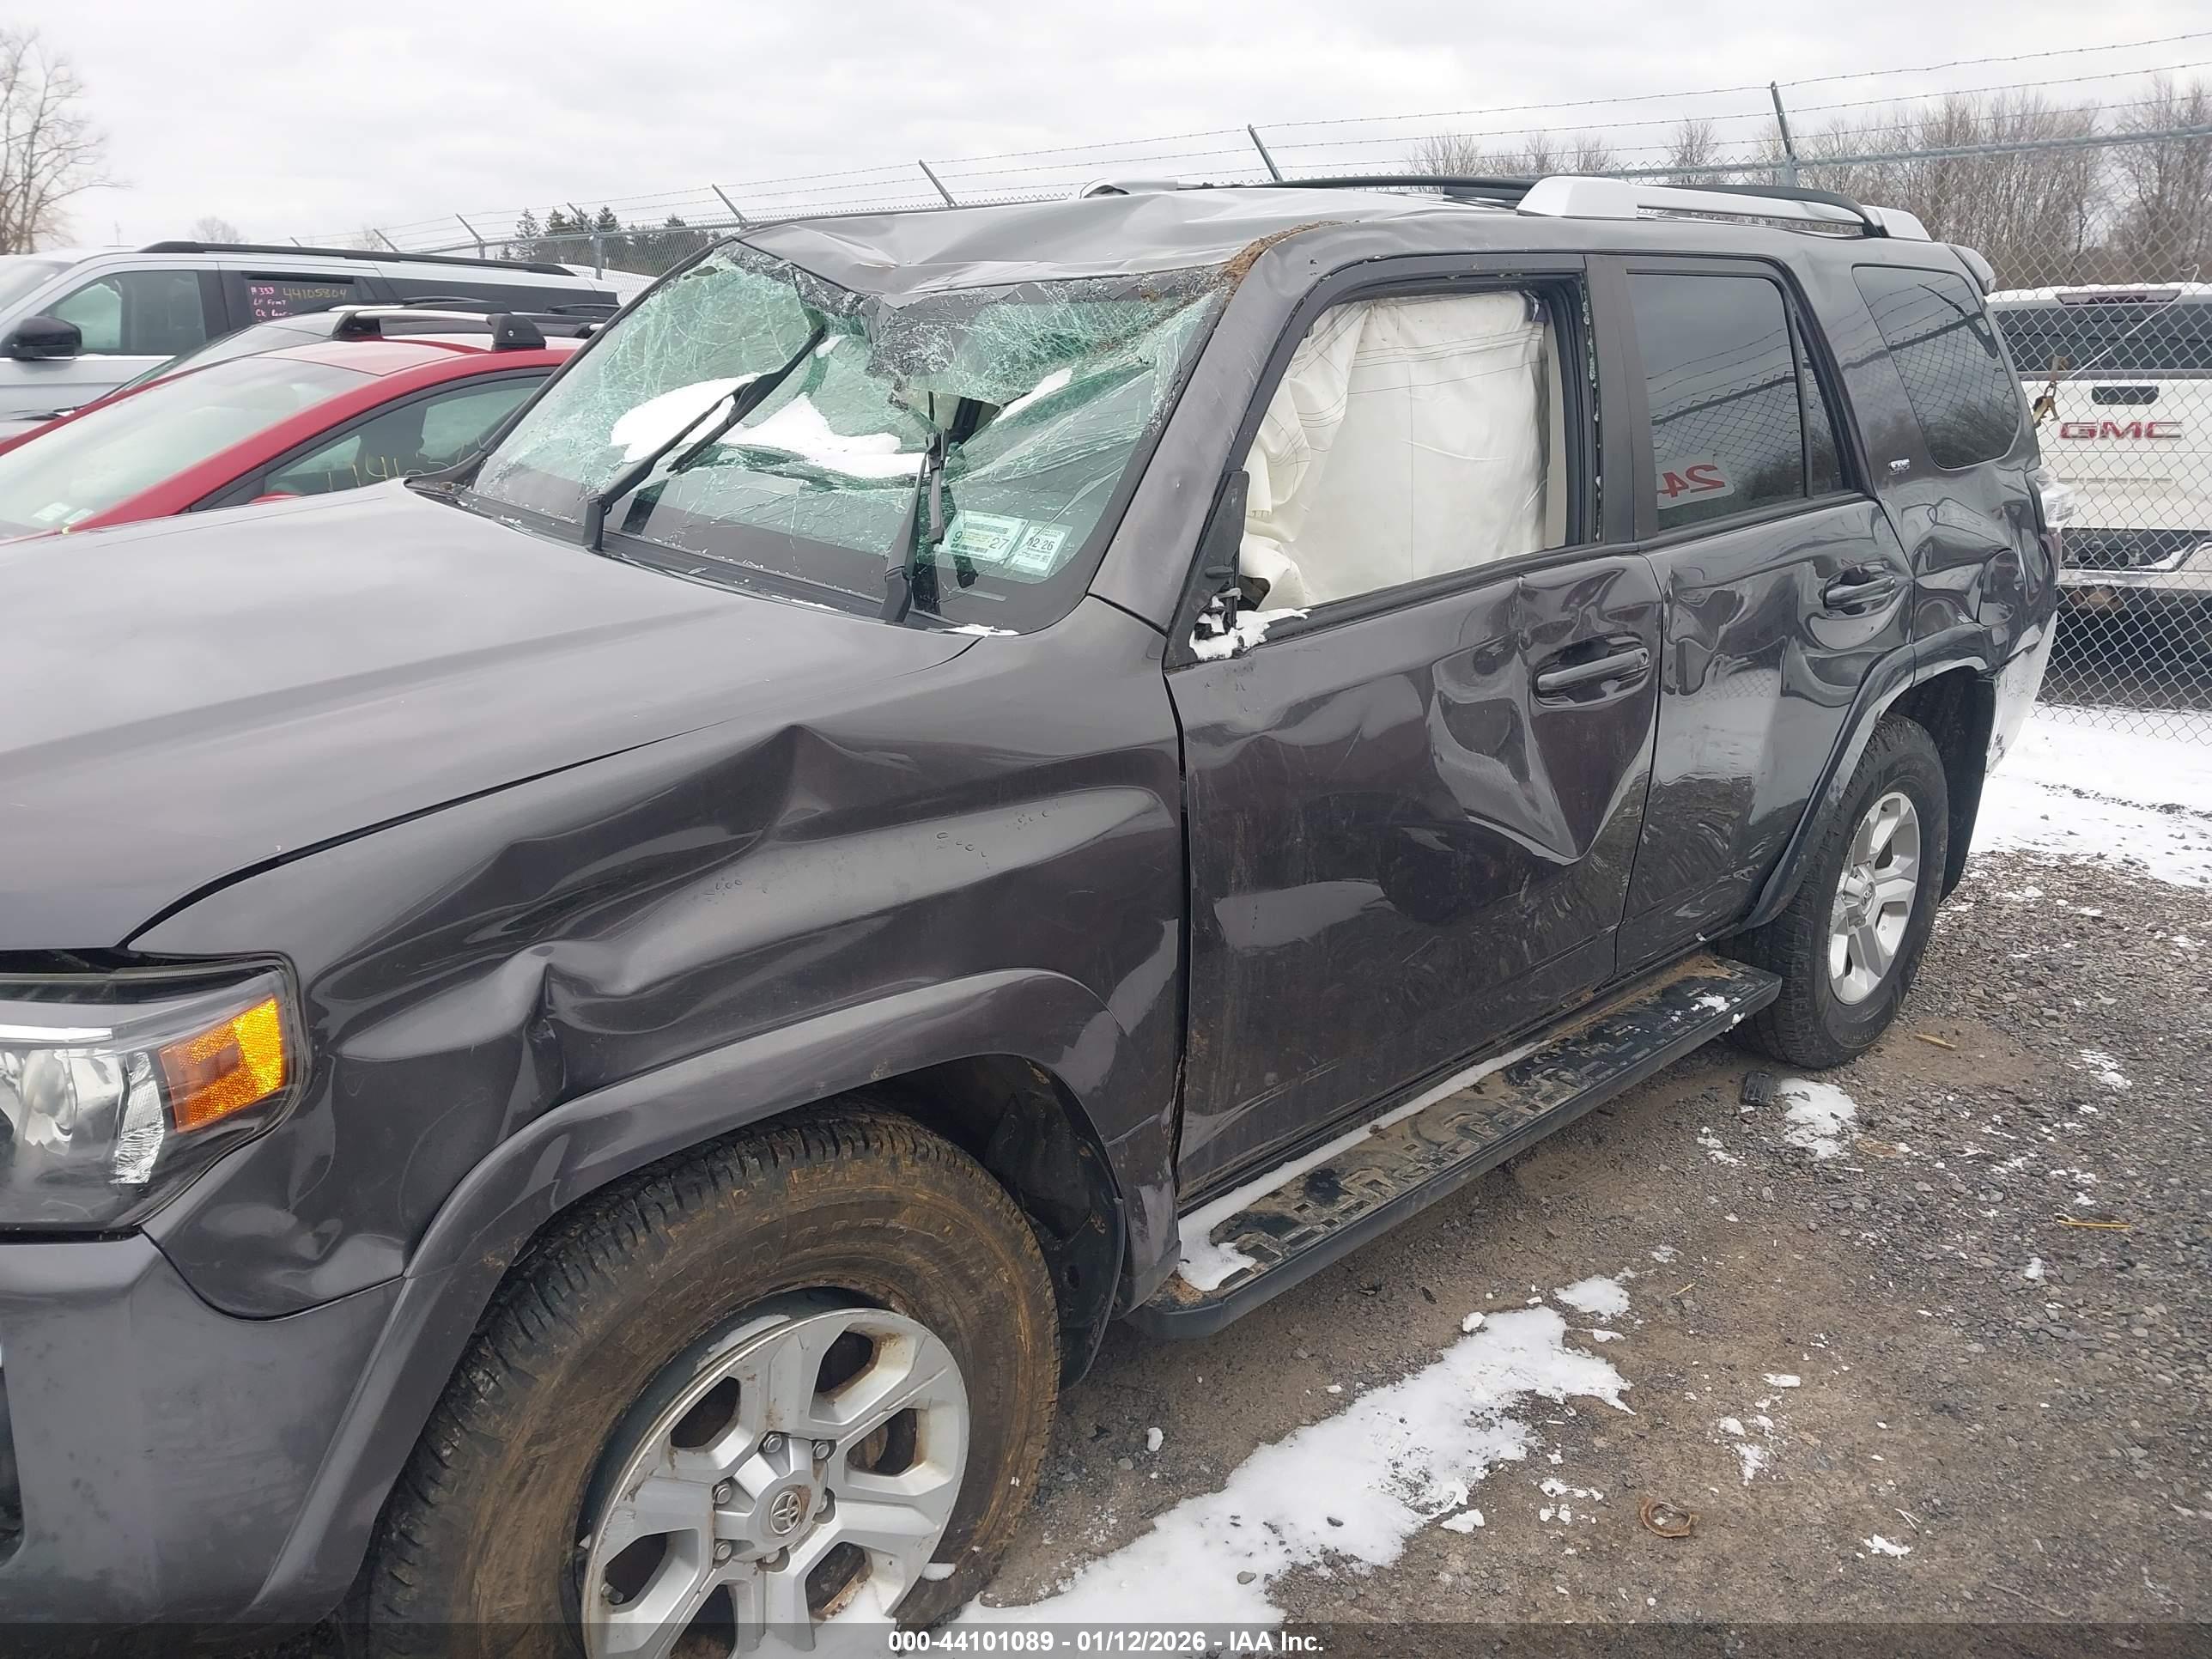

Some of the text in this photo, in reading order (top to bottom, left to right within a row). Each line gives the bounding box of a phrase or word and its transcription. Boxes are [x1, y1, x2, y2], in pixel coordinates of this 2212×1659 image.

[2060, 421, 2184, 440] GMC
[952, 530, 963, 542] 9
[989, 537, 1011, 550] 27
